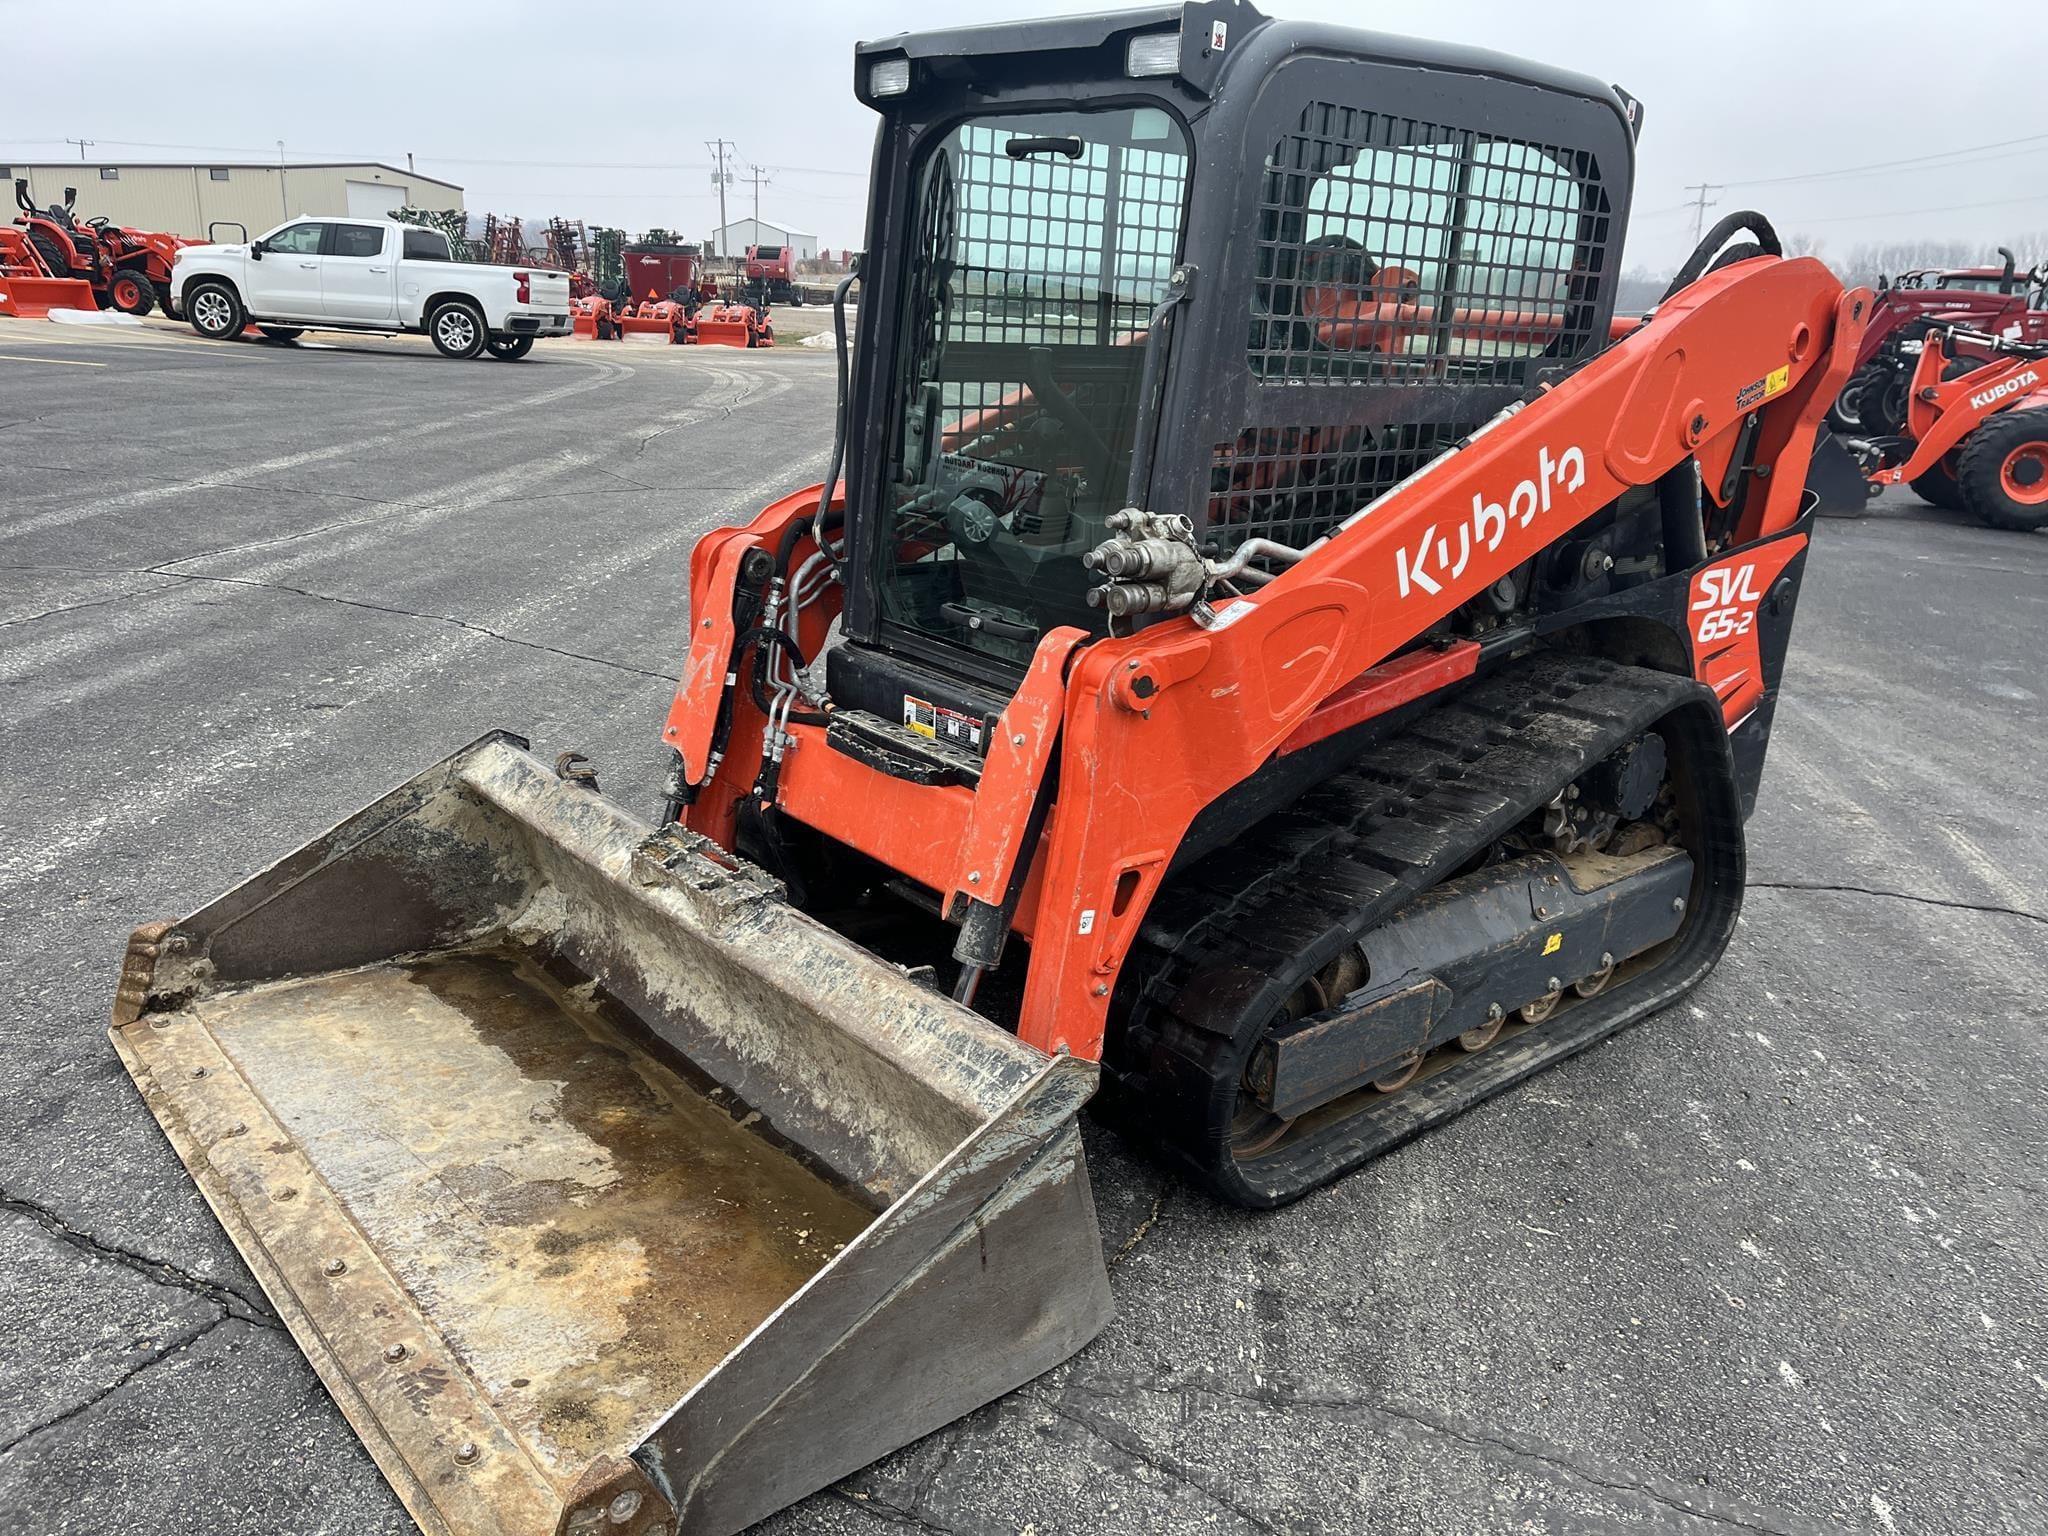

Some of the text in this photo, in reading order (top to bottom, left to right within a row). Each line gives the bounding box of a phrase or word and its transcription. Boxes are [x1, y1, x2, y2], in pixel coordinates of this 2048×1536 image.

[1736, 379, 1766, 403] JOHNSON
[1736, 389, 1765, 411] TRACTOR
[1970, 370, 2039, 409] KUBOTA
[1395, 446, 1585, 599] Kubota
[1691, 564, 1760, 611] SVL
[1697, 607, 1754, 643] 65-2
